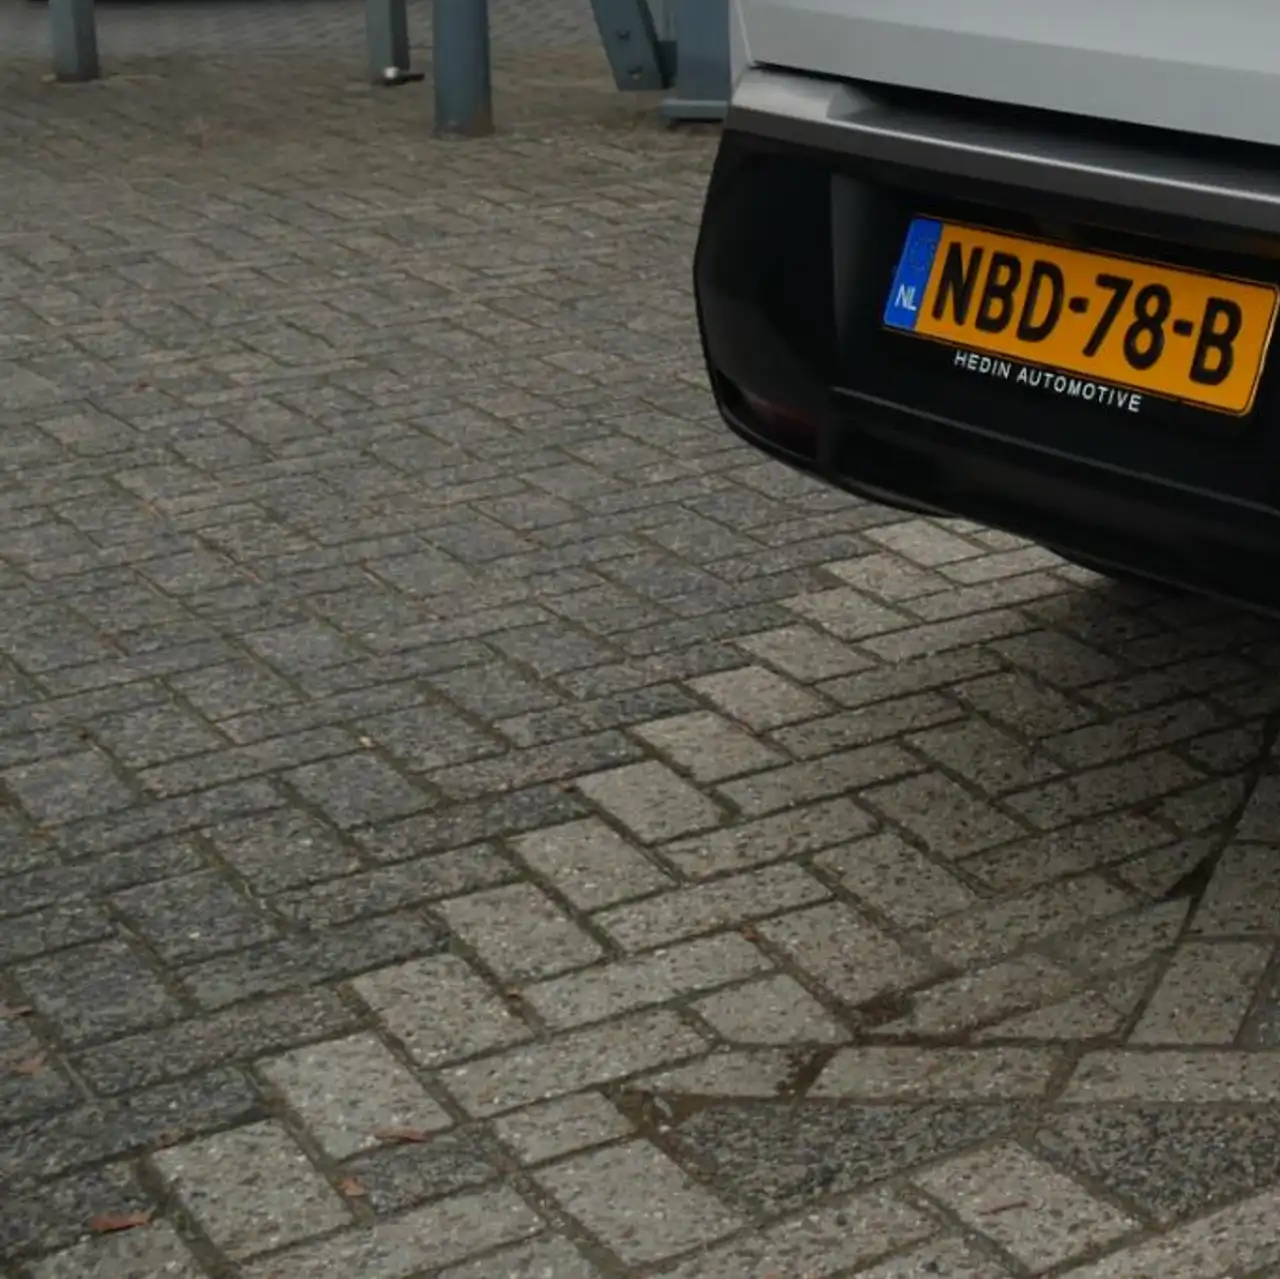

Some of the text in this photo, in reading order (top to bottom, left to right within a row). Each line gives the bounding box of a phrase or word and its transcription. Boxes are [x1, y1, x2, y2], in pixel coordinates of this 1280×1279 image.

[895, 241, 1243, 387] NL NBD-78-B
[953, 349, 1142, 413] HEDIN AUTOMOTIVE
